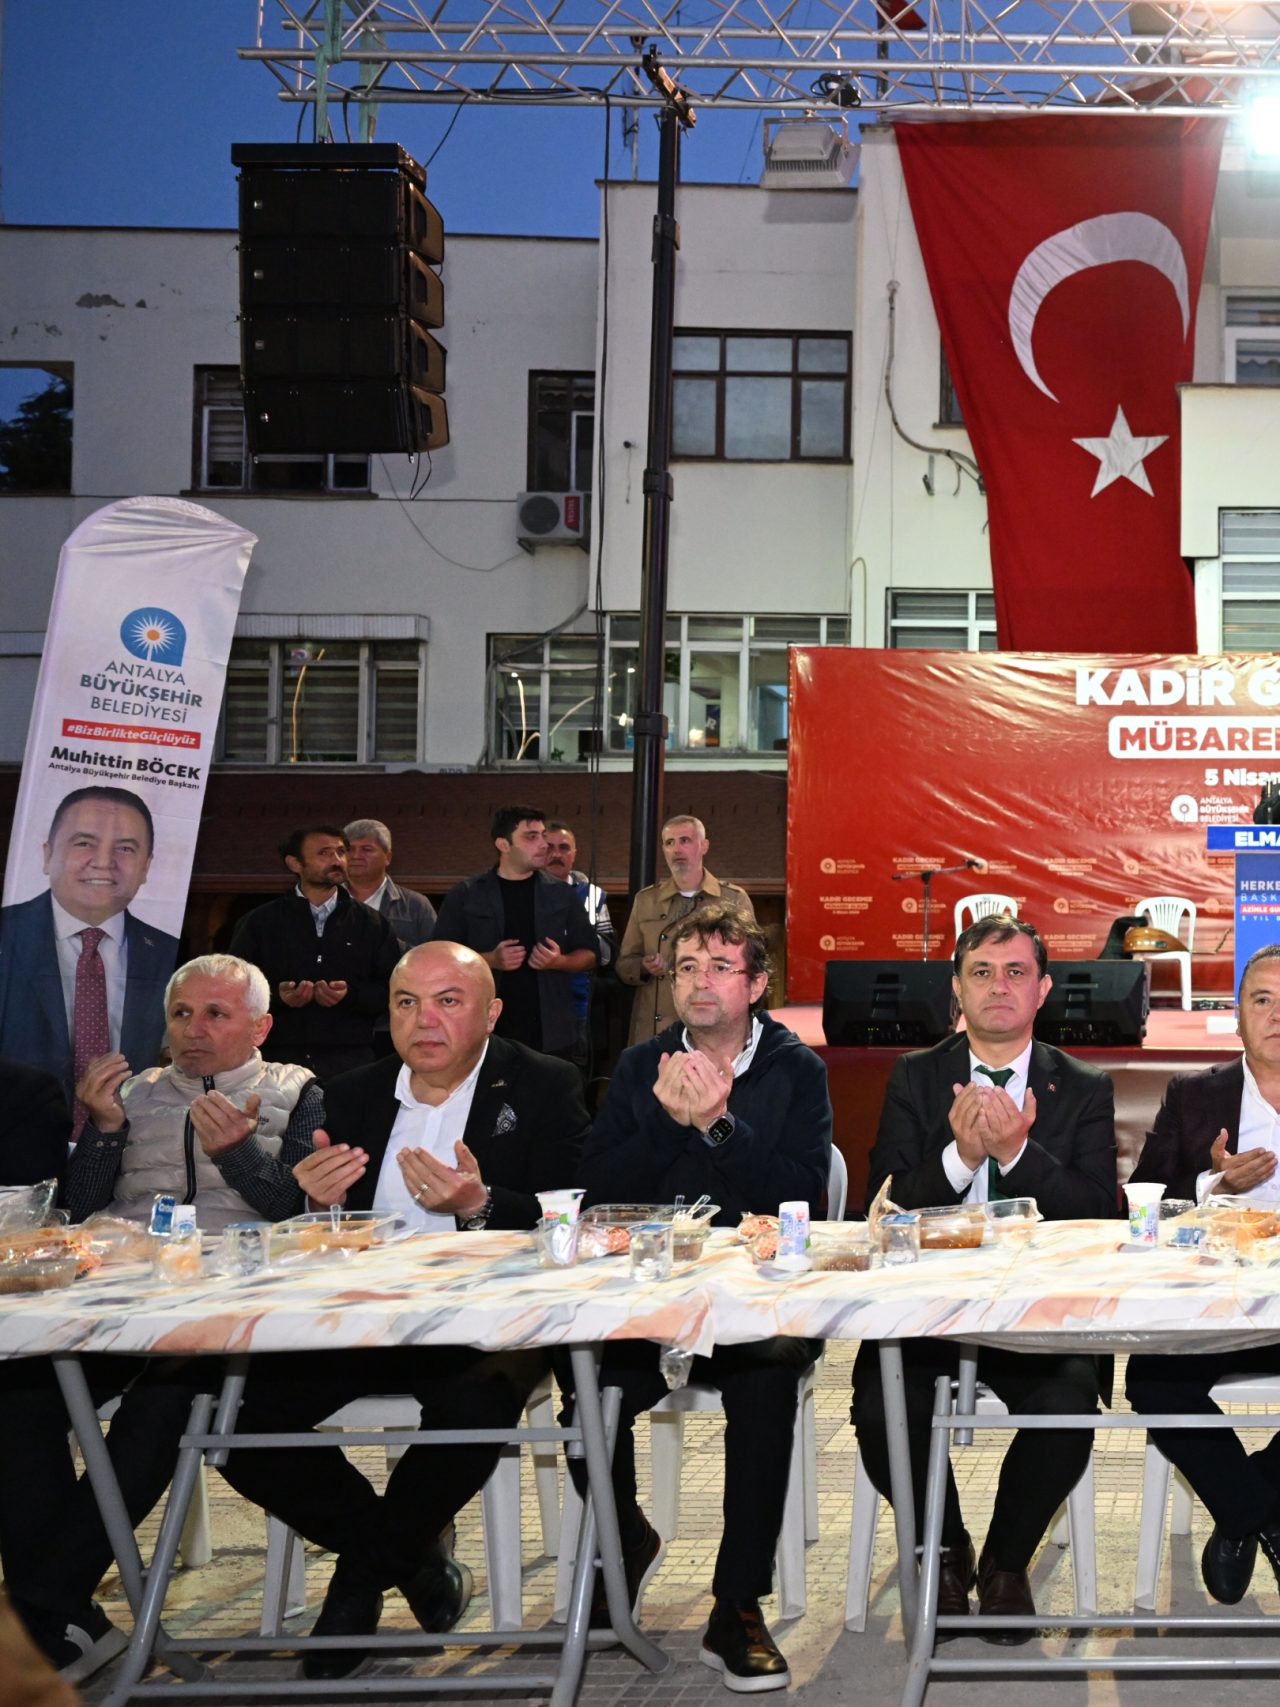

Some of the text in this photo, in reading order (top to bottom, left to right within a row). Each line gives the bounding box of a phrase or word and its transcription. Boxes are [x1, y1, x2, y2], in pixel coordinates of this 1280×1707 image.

[104, 660, 186, 686] ANTALYA
[79, 674, 203, 707] BÜYÜKŞEHİR
[90, 696, 188, 723] BELEDİYESİ
[67, 724, 196, 745] #BizBirlikteGüçlüyüz
[48, 762, 200, 790] Antalya Büyükşehir Belediye Başkanı
[50, 746, 201, 780] Muhittin BÖCEK
[1204, 768, 1219, 787] 5
